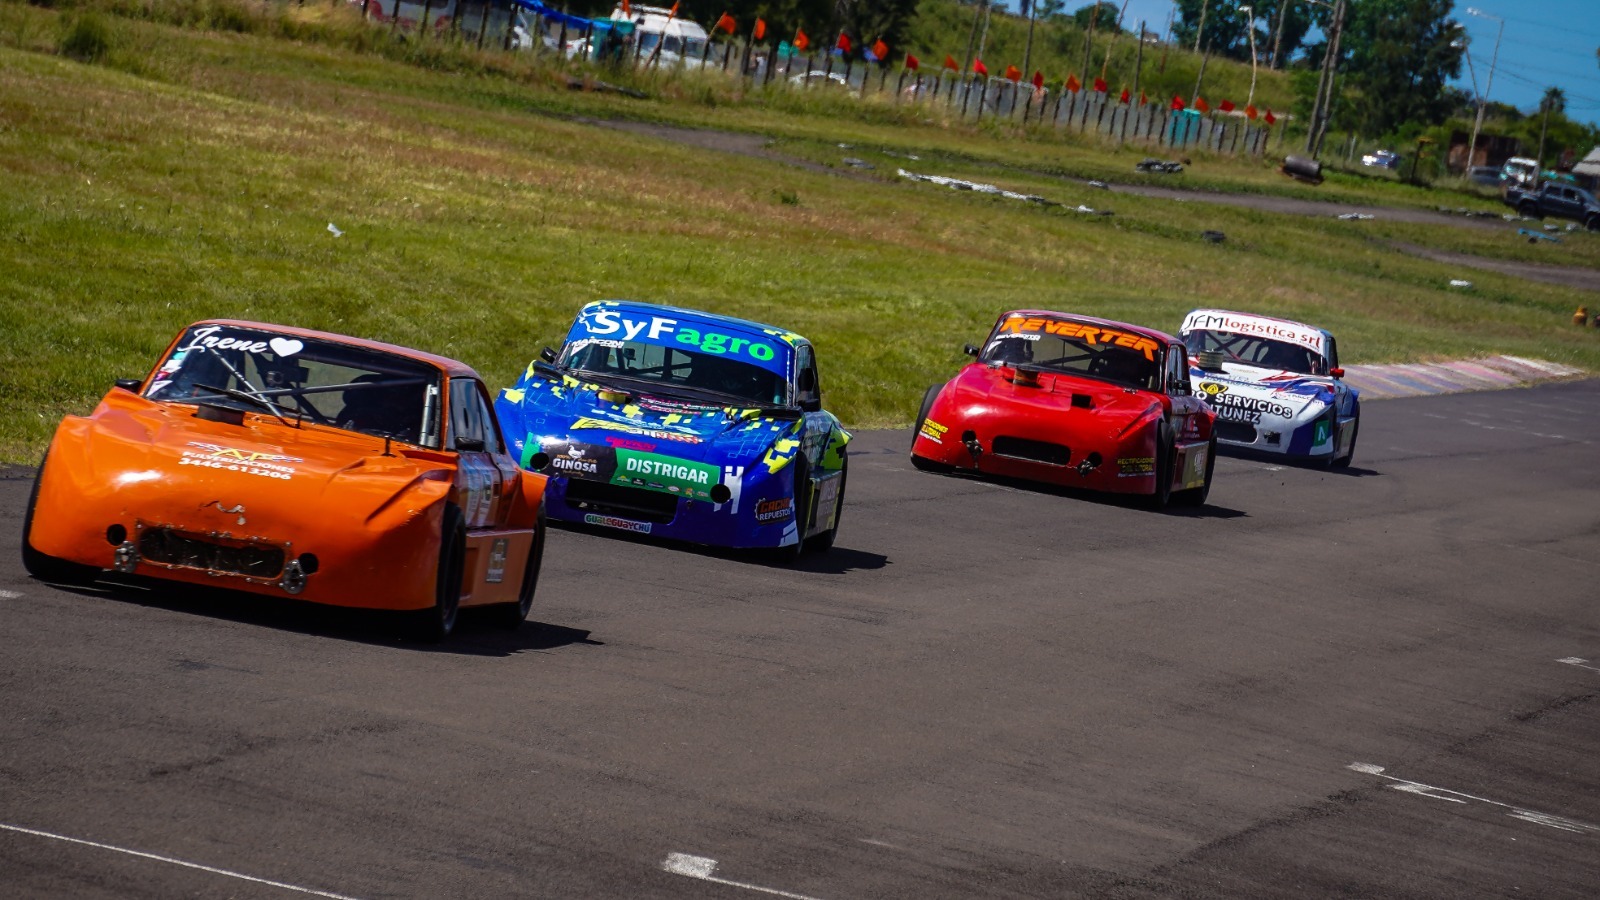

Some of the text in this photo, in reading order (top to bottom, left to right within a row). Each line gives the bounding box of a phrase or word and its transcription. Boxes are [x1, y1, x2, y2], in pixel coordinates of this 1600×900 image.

[177, 326, 268, 353] Irene
[1000, 316, 1159, 362] REVERTER
[1300, 334, 1322, 349] srl
[1215, 393, 1293, 418] SERVICIOS
[178, 458, 292, 480] 3446-613206
[182, 451, 295, 474] PULVERIZACIONES
[552, 458, 598, 473] GINOSA
[626, 457, 709, 485] DISTRIGAR
[759, 508, 791, 521] REPUESTOS
